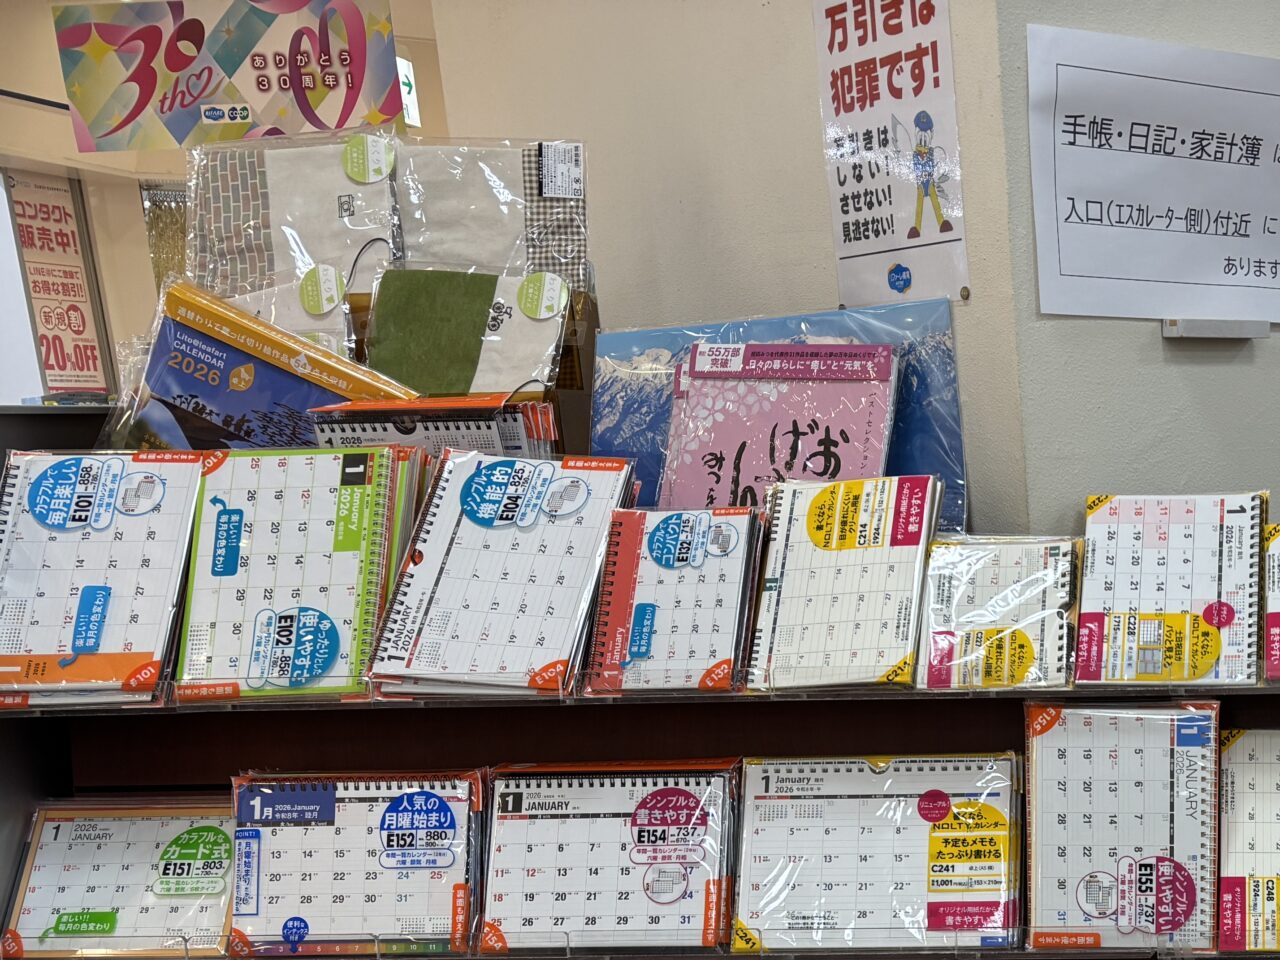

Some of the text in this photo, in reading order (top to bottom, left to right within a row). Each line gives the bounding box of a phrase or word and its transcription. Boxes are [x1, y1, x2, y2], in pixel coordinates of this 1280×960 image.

[825, 0, 936, 54] 万引きは
[252, 52, 352, 69] ありがとう
[830, 40, 940, 117] 犯罪です!
[1062, 115, 1264, 166] 手帳・日記・家計簿
[839, 184, 893, 215] させない!
[14, 200, 74, 225] コンタクト
[1262, 215, 1279, 235] に
[707, 346, 742, 359] 55万部
[46, 459, 77, 526] 毎月楽しい
[72, 494, 94, 524] E101
[348, 487, 364, 530] January
[499, 493, 523, 524] E104
[907, 488, 923, 533] 書きやすい
[657, 513, 681, 566] コンパクト
[857, 522, 868, 547] C214
[676, 539, 692, 564] E132
[85, 589, 107, 647] 毎月の色変わり
[277, 615, 294, 647] E102
[1185, 750, 1199, 821] JANUARY
[399, 795, 440, 811] 人気の
[525, 801, 570, 812] JANUARY
[645, 795, 698, 808] シンプルな
[384, 812, 452, 829] 月曜始まり
[635, 809, 704, 825] 書きやすさ
[180, 832, 225, 843] カラフルな
[386, 832, 415, 849] E152
[637, 828, 668, 844] E154
[941, 837, 998, 848] 予定もメモも
[163, 844, 230, 860] カード式
[936, 850, 1002, 860] たっぷり書ける
[162, 862, 192, 877] E151
[931, 863, 956, 873] C241
[1138, 863, 1154, 894] E155
[1158, 861, 1174, 931] 使いやすい
